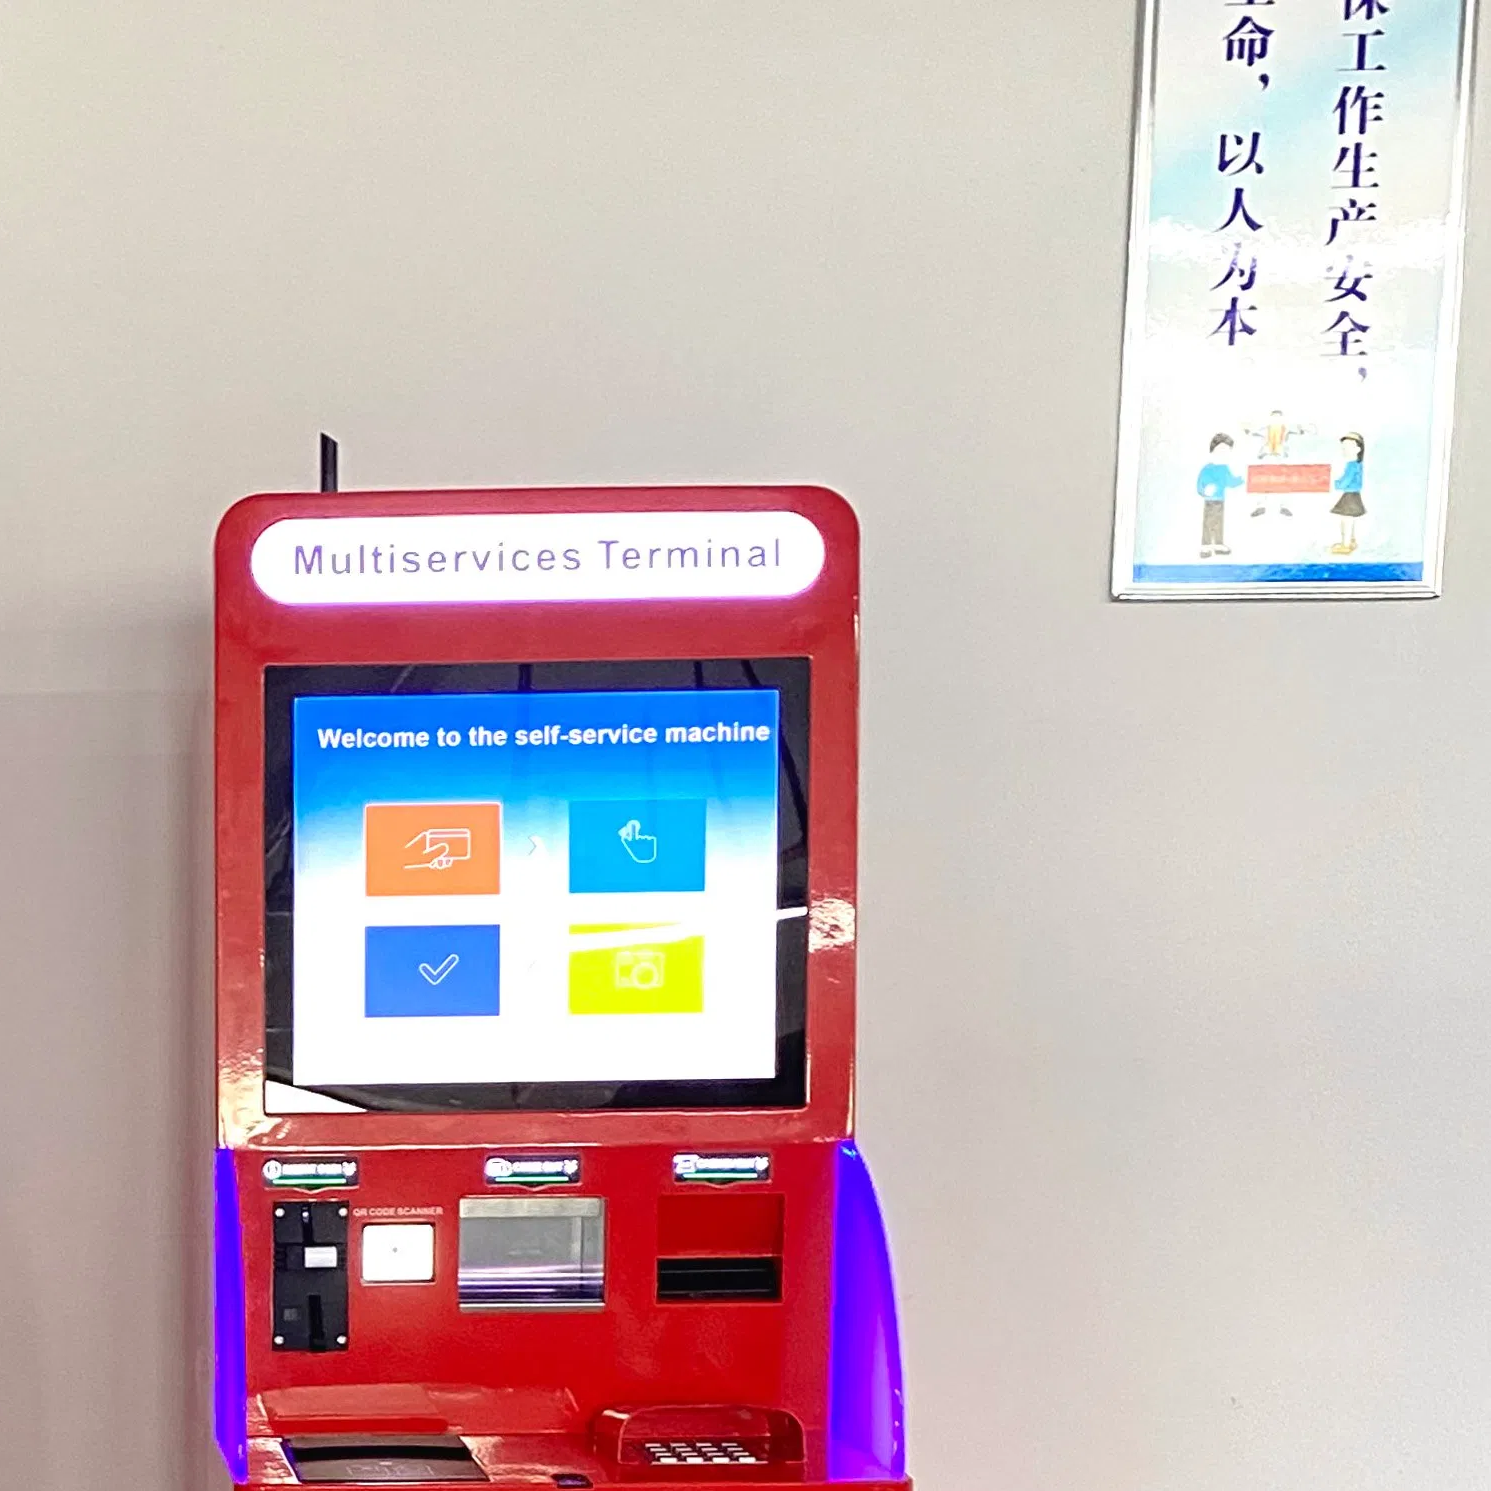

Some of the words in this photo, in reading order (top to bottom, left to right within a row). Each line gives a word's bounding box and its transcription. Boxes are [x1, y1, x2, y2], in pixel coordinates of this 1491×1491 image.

[1207, 0, 1275, 346] 命，以人为本
[295, 543, 582, 575] Multiservices
[597, 539, 780, 570] Terminal
[317, 727, 429, 749] Welcome
[437, 728, 461, 747] to
[468, 726, 507, 747] the
[514, 724, 658, 746] self-service
[665, 721, 771, 743] machine
[369, 1207, 396, 1216] CODE
[396, 1206, 444, 1216] SCANNER
